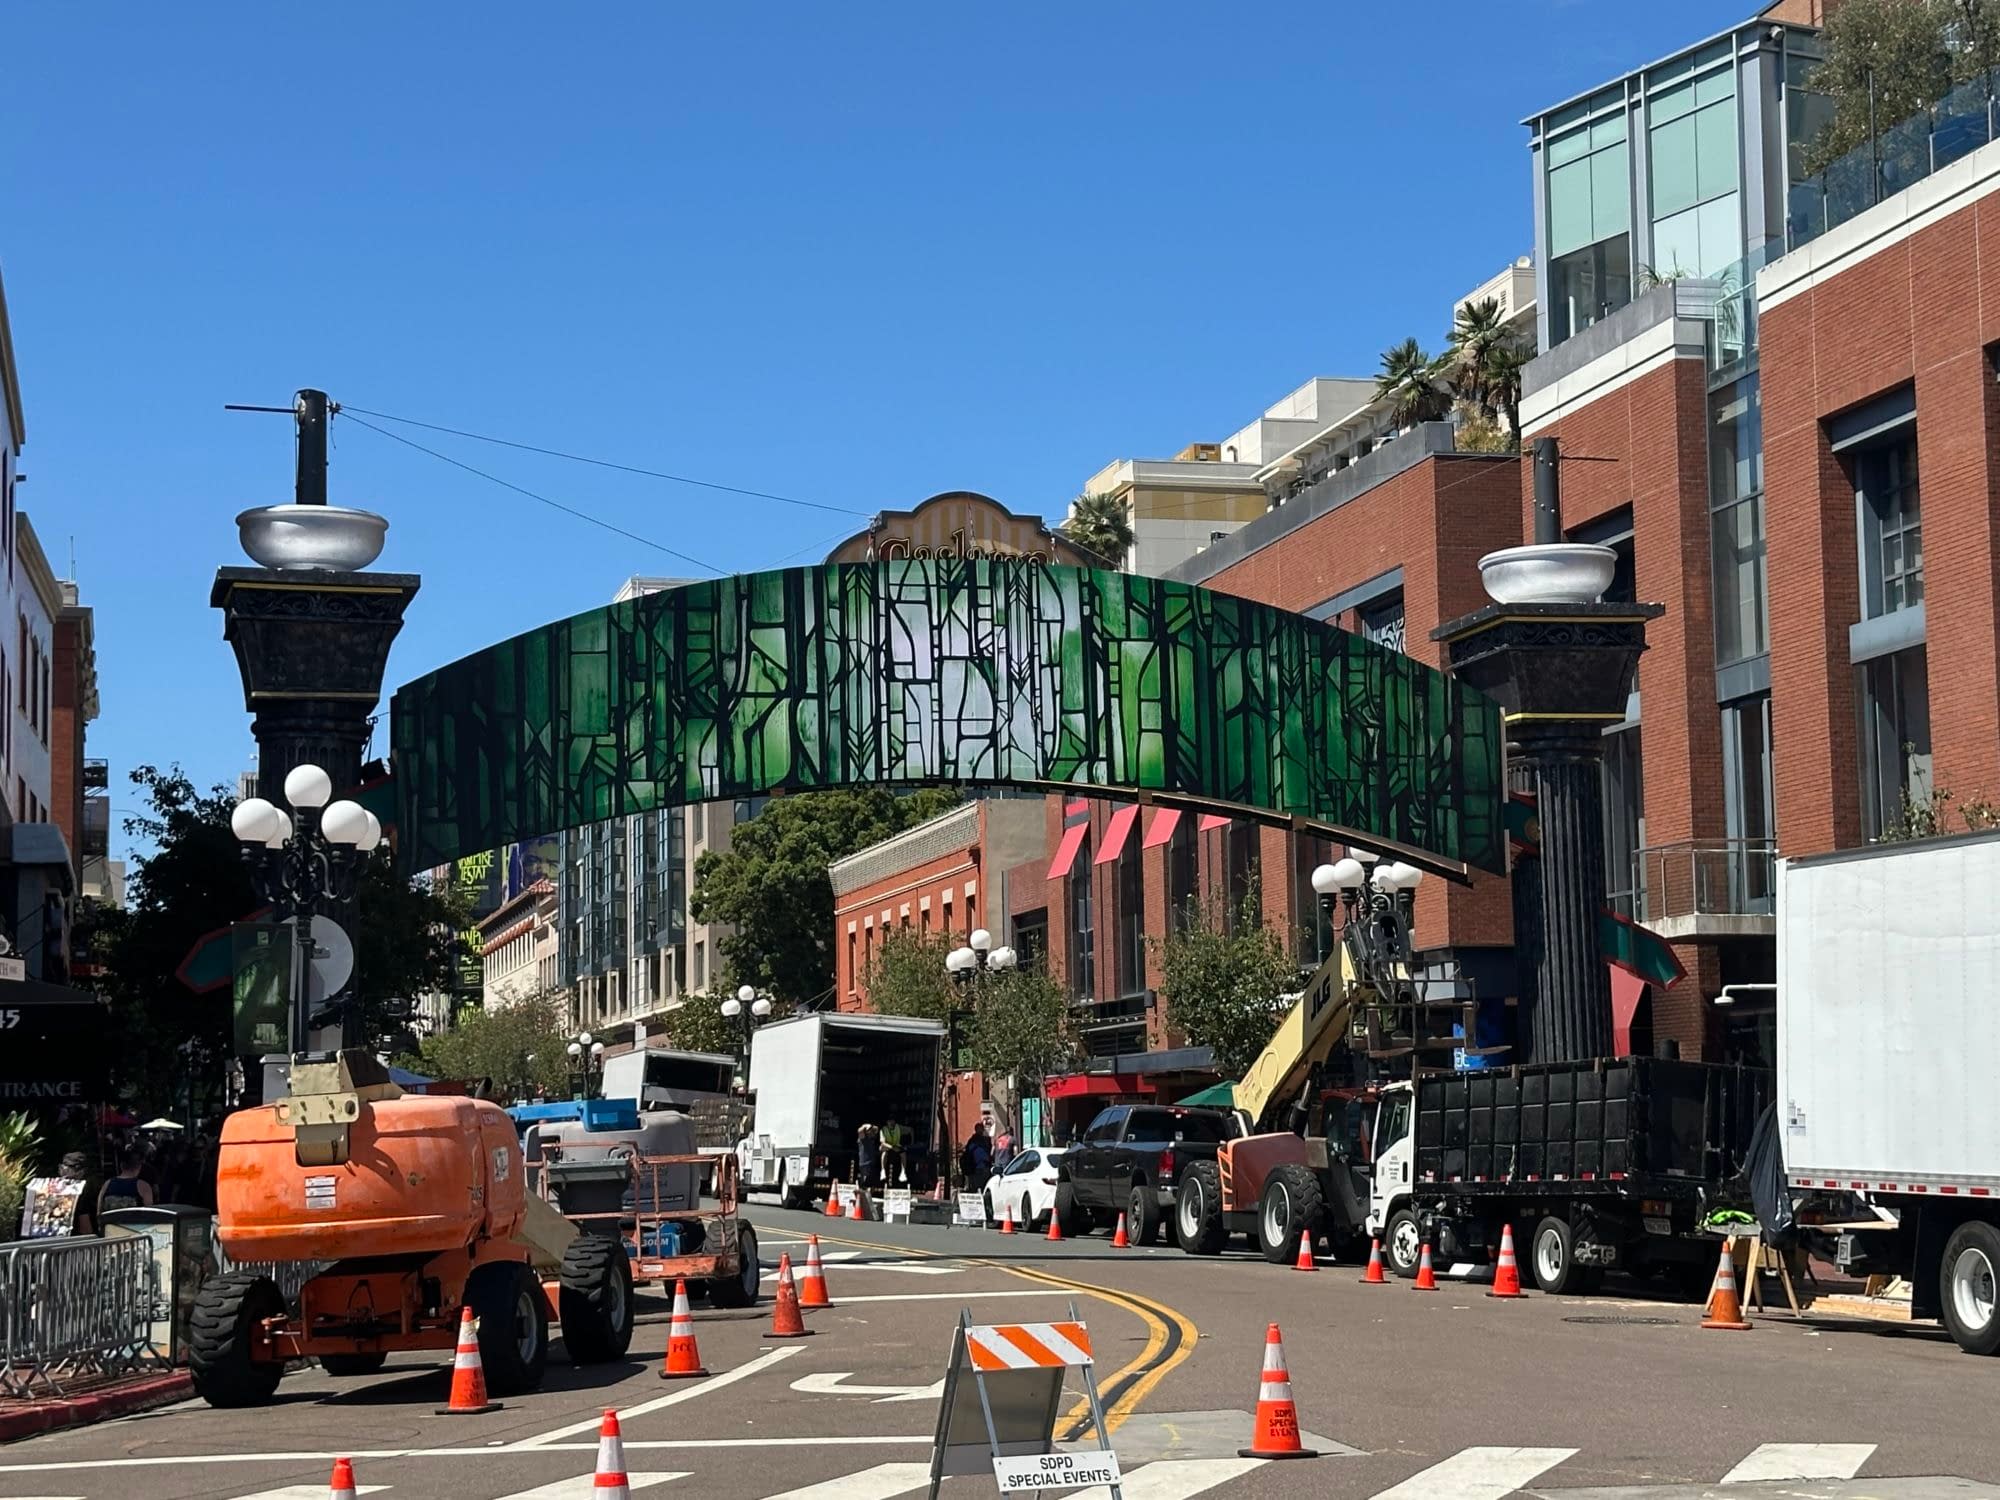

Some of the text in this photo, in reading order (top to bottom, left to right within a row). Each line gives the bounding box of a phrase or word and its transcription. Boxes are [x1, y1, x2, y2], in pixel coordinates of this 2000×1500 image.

[1310, 973, 1331, 1022] JLG
[0, 1081, 81, 1097] TRANCE
[1039, 1456, 1074, 1471] SDPD
[1007, 1468, 1112, 1488] SPECIAL EVENTS
